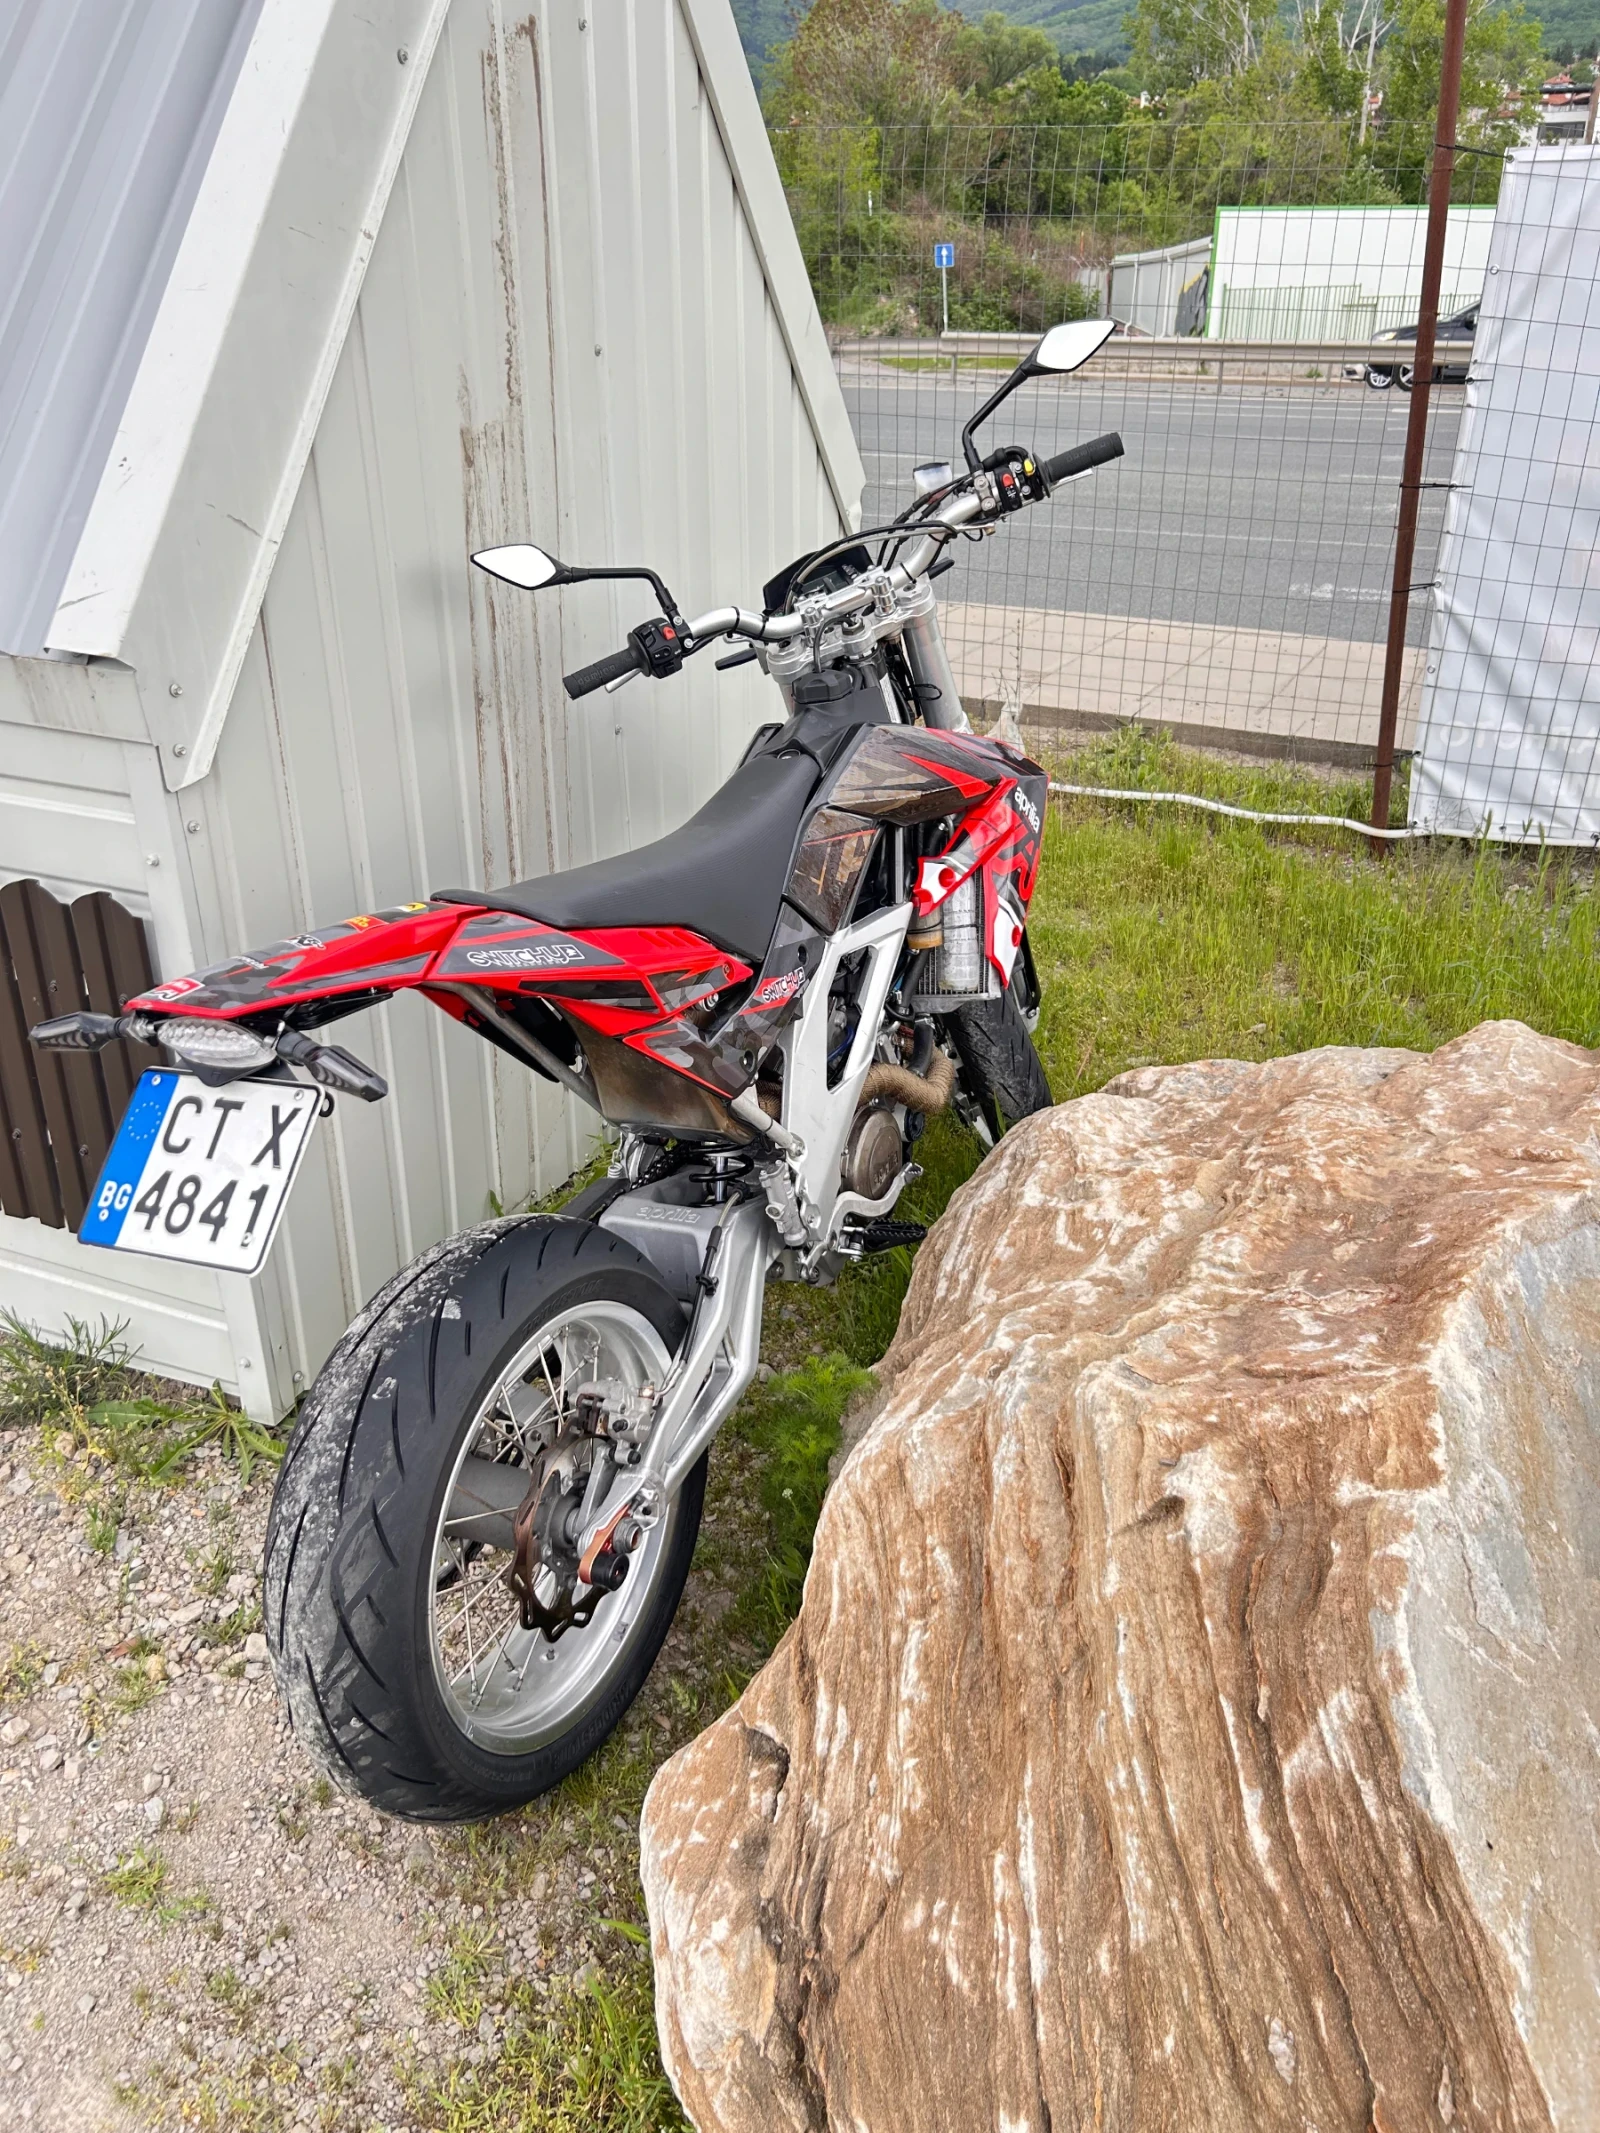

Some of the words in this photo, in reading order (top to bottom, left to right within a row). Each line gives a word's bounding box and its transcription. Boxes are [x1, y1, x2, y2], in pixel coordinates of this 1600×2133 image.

[1014, 786, 1040, 834] aprilia
[162, 1096, 245, 1160] CT
[250, 1105, 303, 1169] X
[97, 1180, 133, 1211] BG
[134, 1170, 269, 1248] 4841
[636, 1206, 702, 1225] aprilia
